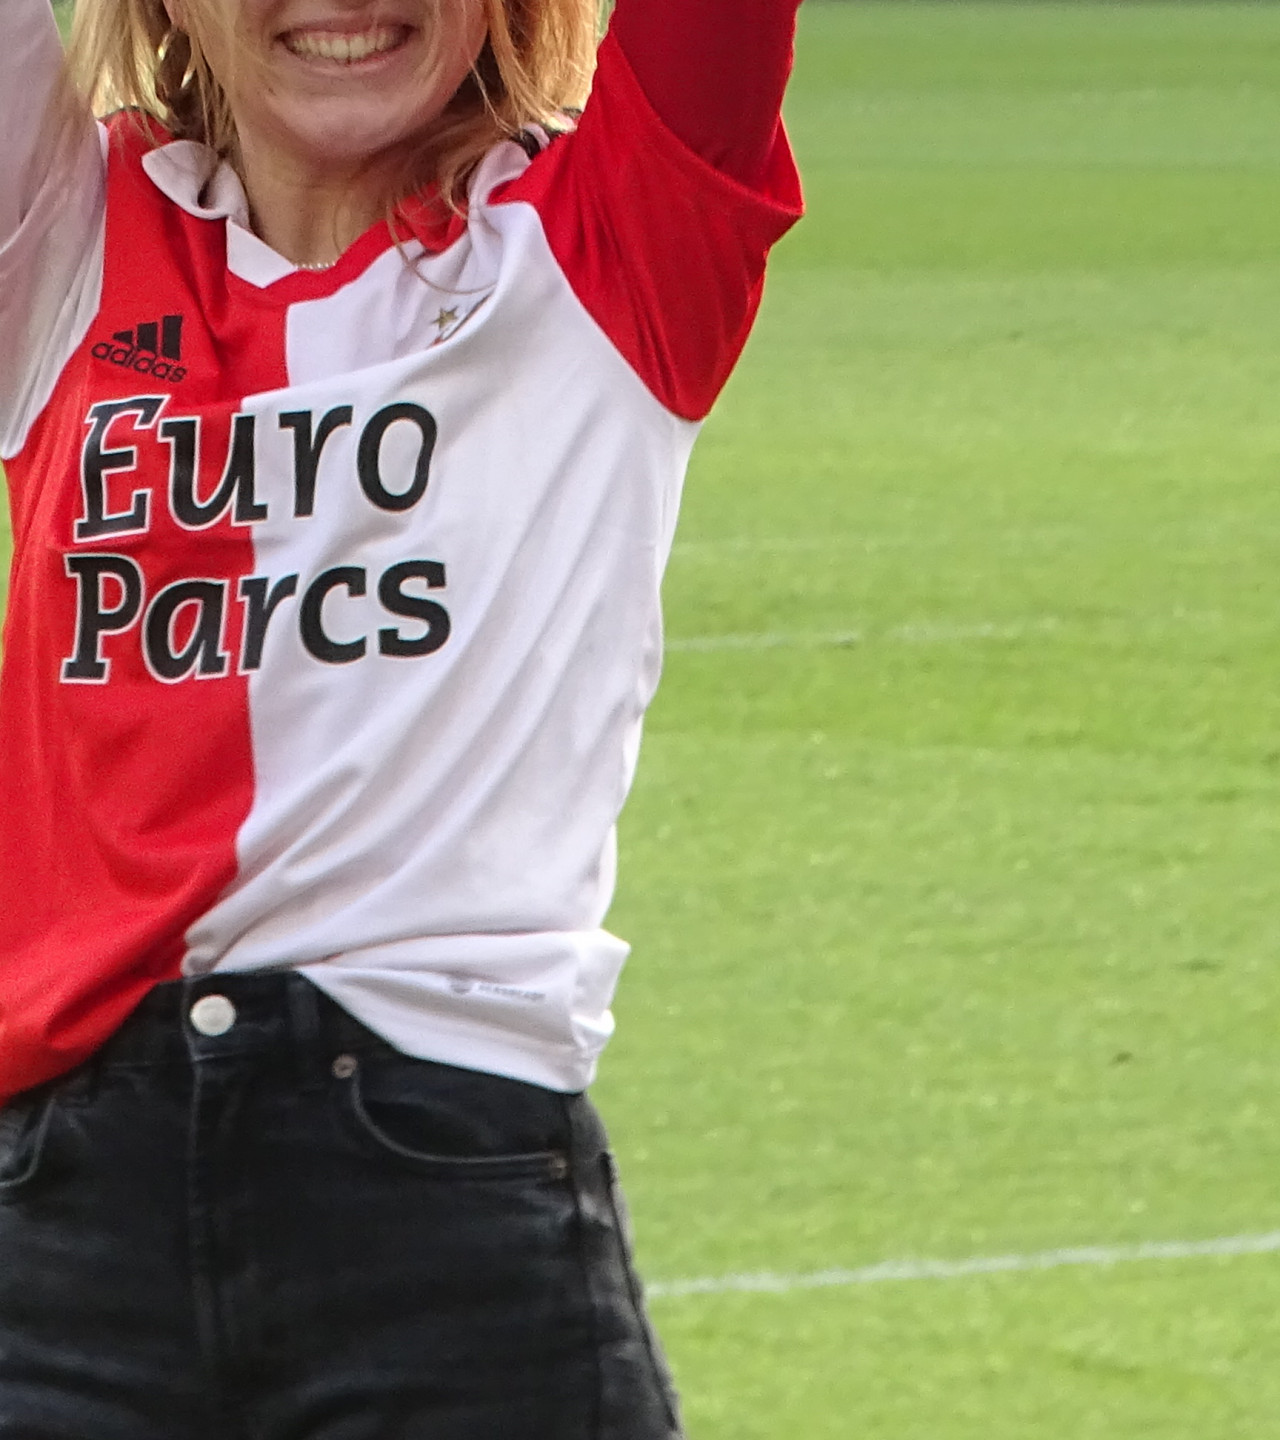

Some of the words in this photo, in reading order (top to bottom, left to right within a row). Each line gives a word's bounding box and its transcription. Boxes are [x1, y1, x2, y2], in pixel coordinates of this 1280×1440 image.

[91, 342, 187, 382] adidas
[73, 394, 438, 542] Euro
[58, 553, 452, 685] Parcs
